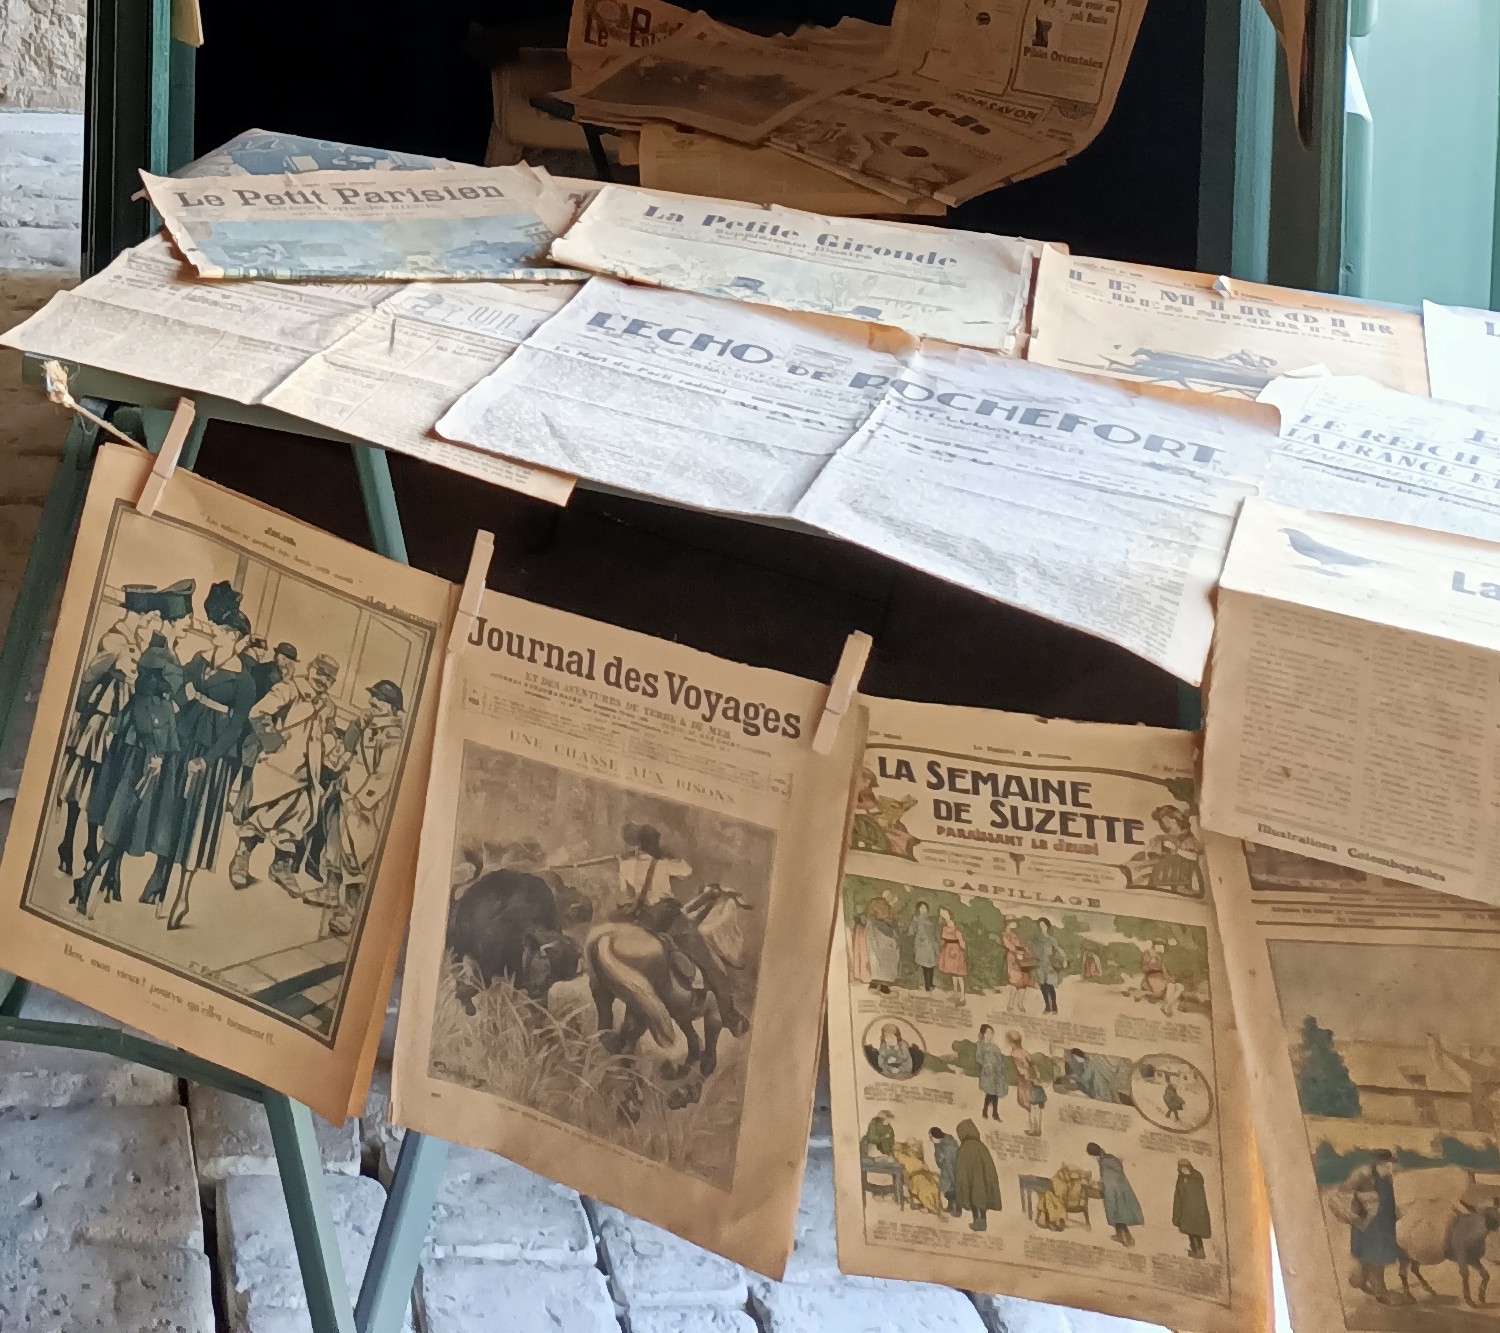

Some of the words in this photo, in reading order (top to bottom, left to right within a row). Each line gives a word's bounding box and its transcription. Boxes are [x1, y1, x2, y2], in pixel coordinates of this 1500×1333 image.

[173, 190, 226, 208] Le
[233, 187, 329, 207] Petit
[332, 182, 505, 206] Parisien
[643, 205, 684, 223] La
[701, 214, 800, 239] Petite
[816, 232, 958, 267] Gironde
[787, 363, 840, 382] DE
[848, 371, 1228, 464] ROCHEFORT
[1337, 440, 1456, 478] FRANCE
[467, 615, 596, 681] Journal
[604, 655, 660, 699] des
[663, 669, 801, 740] Voyages
[510, 729, 543, 749] UNE
[554, 743, 618, 771] CHASSE
[878, 756, 917, 784] LA
[926, 760, 1093, 809] SEMAINE
[933, 798, 972, 825] DE
[989, 799, 1146, 846] SUZETTE
[942, 878, 1102, 908] GASPILLAGE
